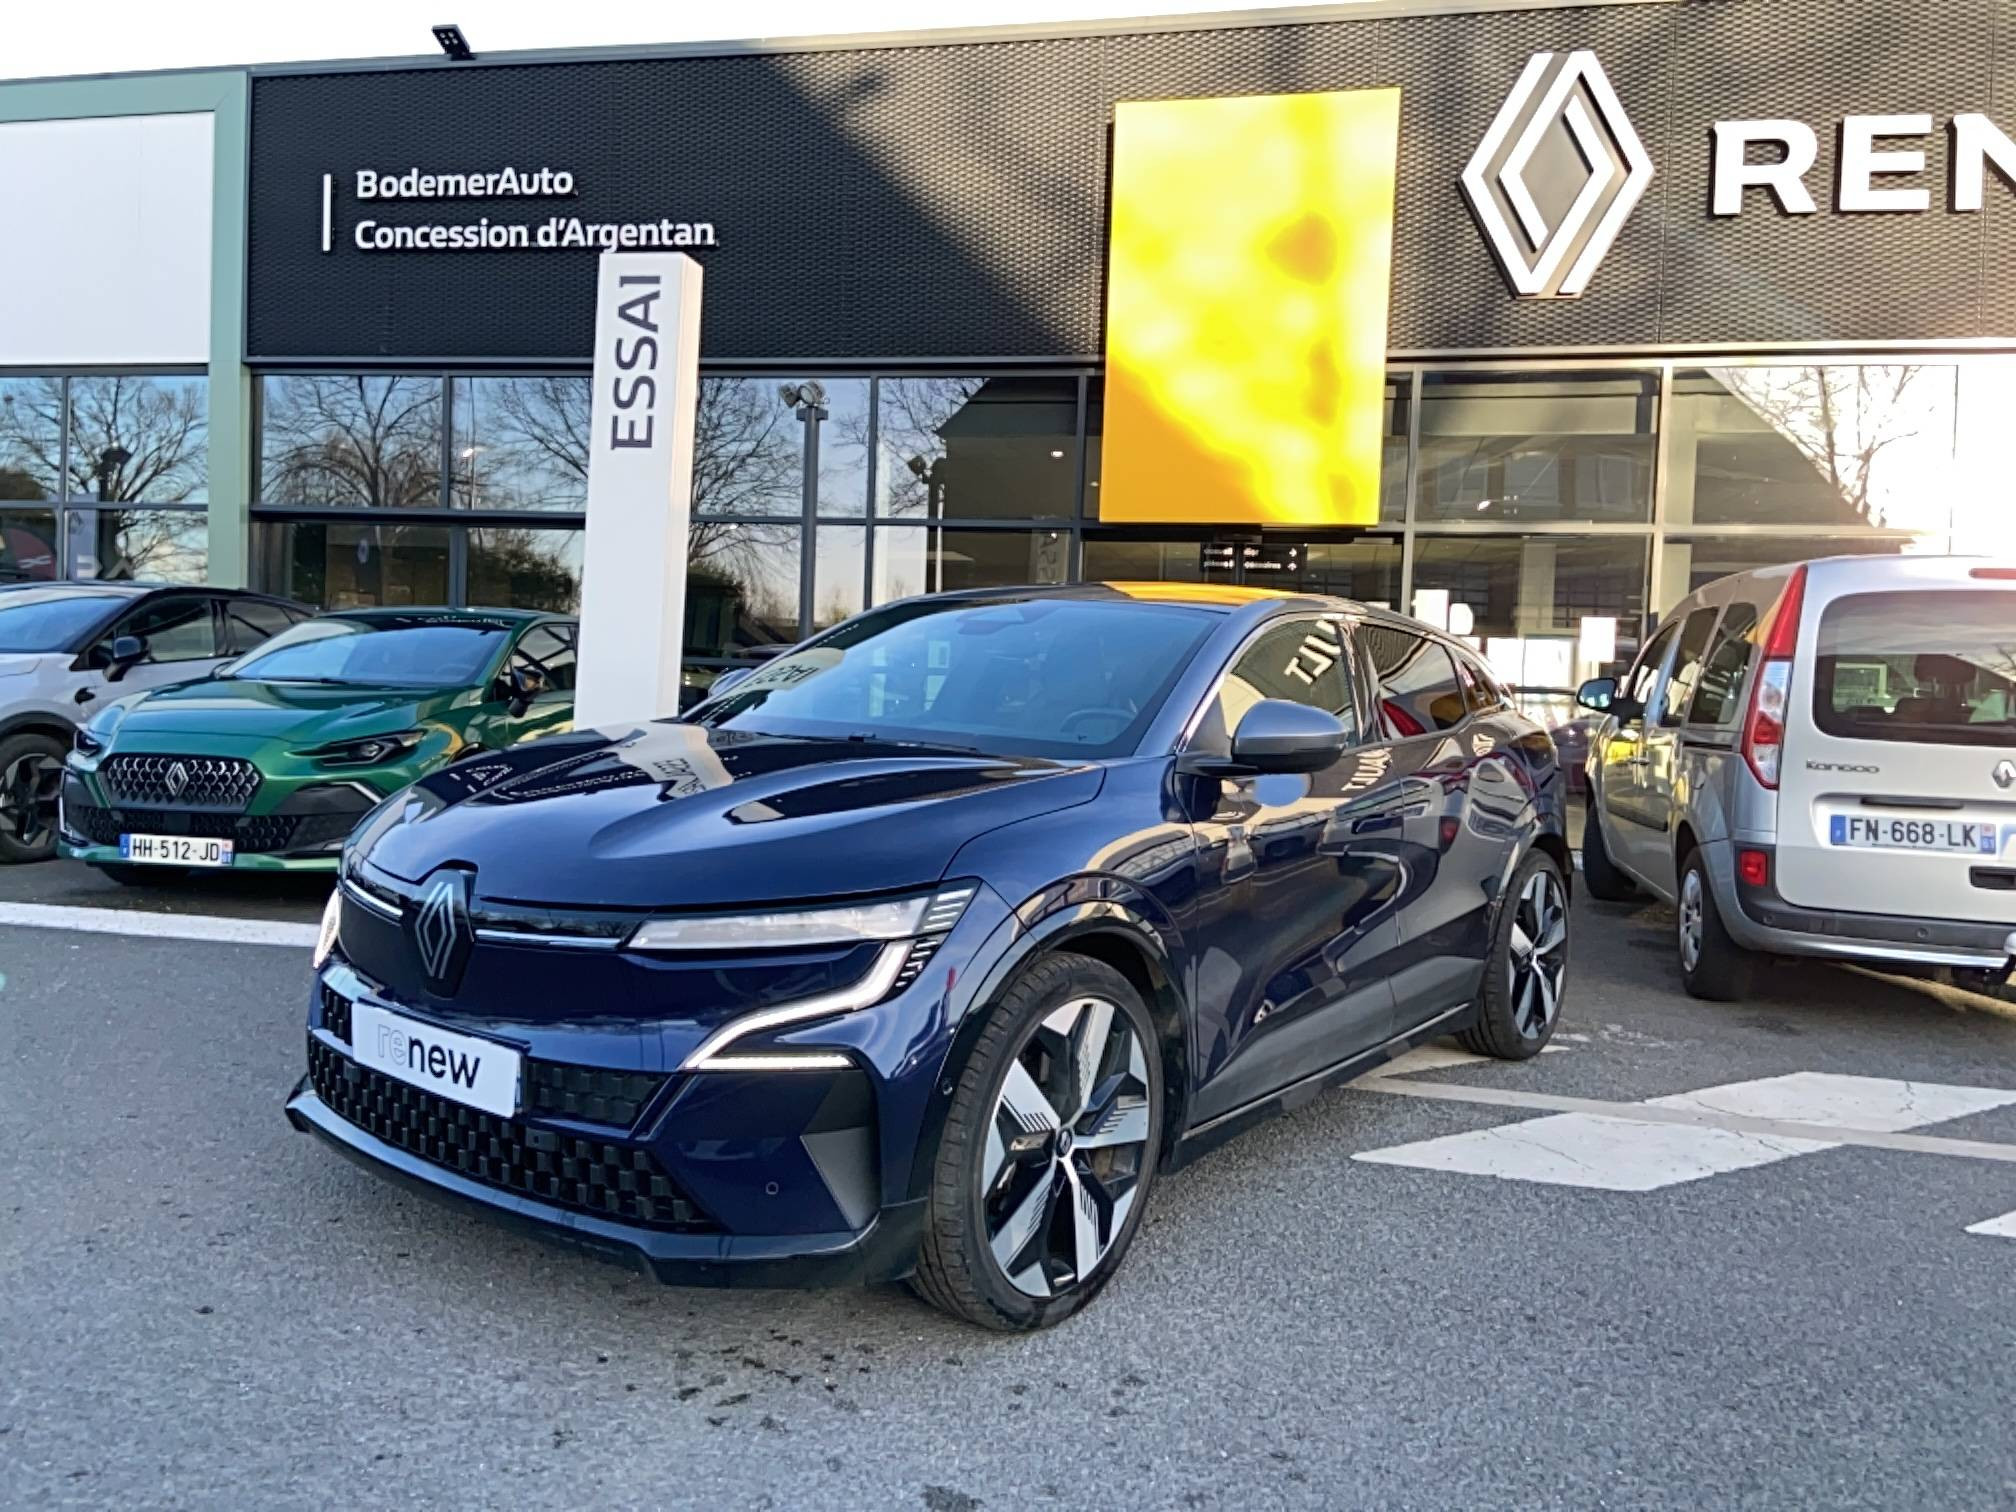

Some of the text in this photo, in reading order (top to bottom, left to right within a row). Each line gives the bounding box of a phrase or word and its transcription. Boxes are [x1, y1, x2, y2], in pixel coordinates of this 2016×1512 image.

[356, 167, 574, 199] BodemerAuto
[354, 217, 529, 249] Concession
[611, 275, 661, 450] ESSAI
[1850, 818, 1976, 847] FN-668-LK
[133, 838, 219, 861] HH-512-JD
[378, 1024, 481, 1089] renew
